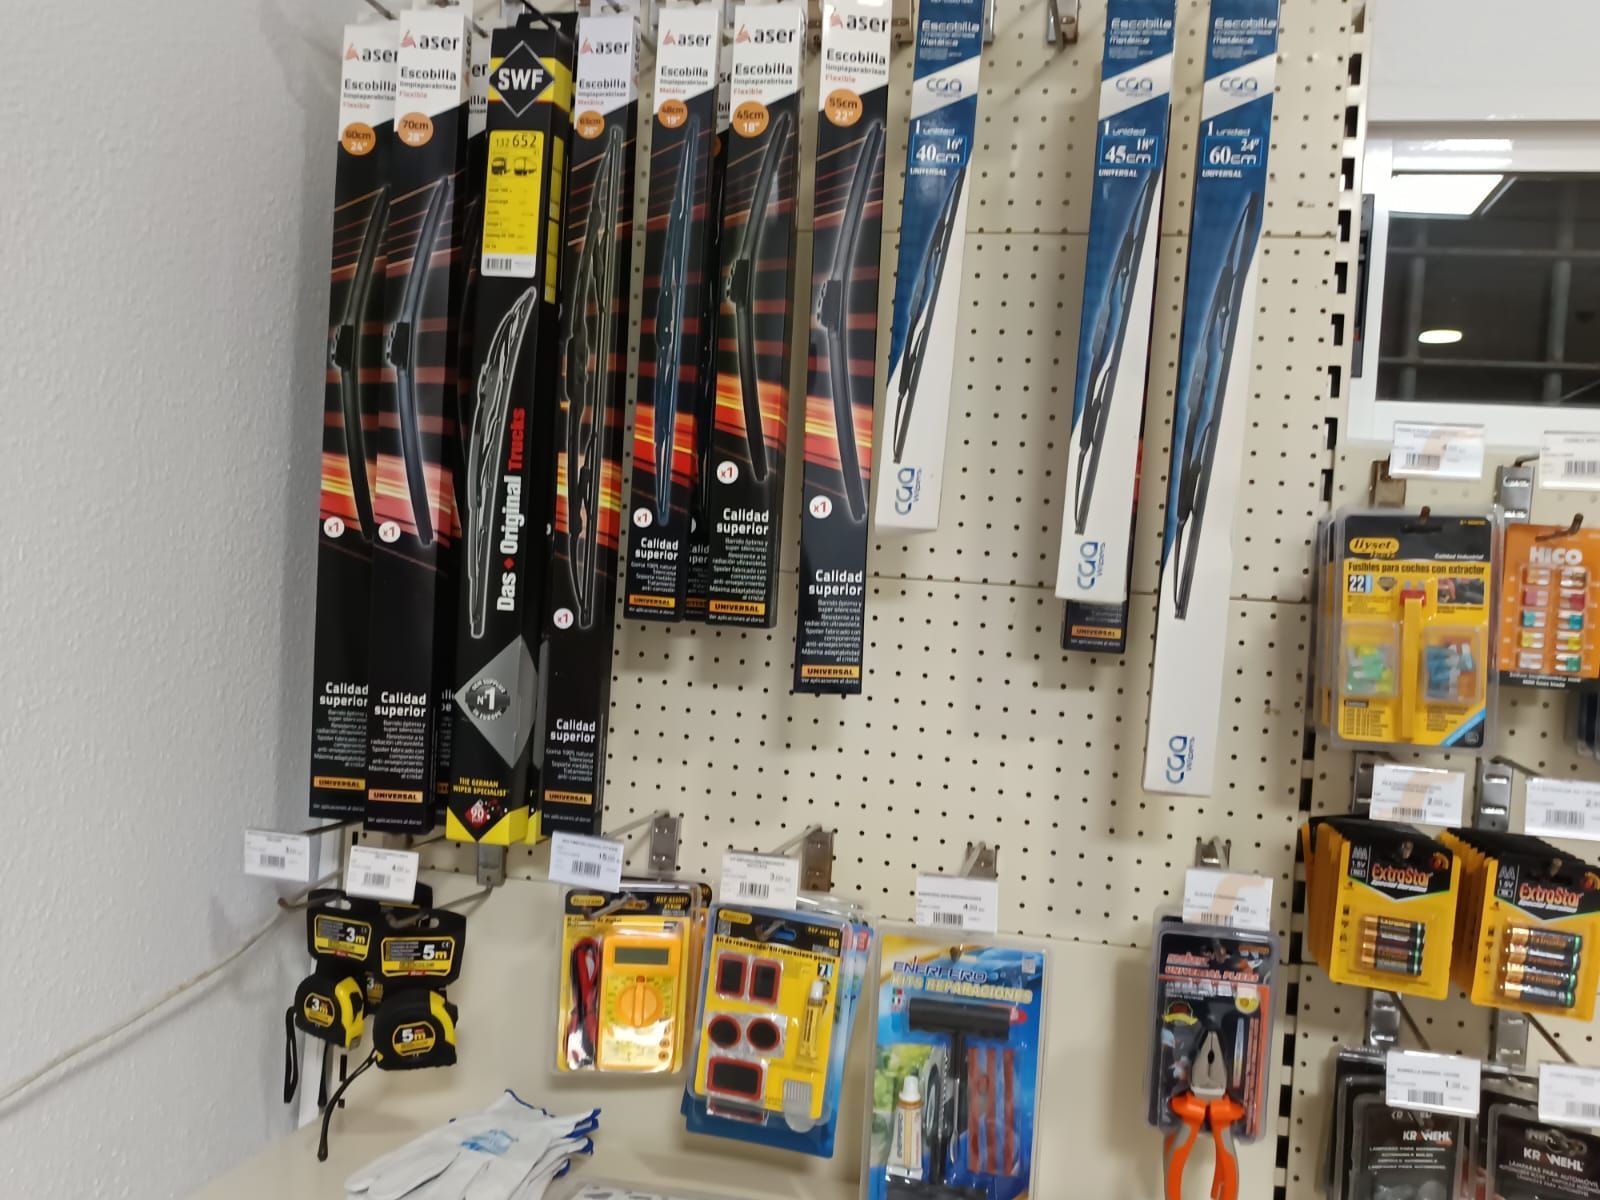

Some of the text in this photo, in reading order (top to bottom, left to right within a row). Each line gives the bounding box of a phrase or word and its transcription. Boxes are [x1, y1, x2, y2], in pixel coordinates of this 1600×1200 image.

[826, 48, 886, 65] Escobilla
[400, 66, 457, 81] Escobilla
[661, 66, 708, 78] Escobilla
[735, 62, 793, 76] Escobilla
[344, 78, 397, 93] Escobilla
[498, 68, 544, 90] SWF
[578, 78, 626, 90] Escobilla
[402, 118, 429, 132] 70cm
[512, 133, 537, 148] 652
[916, 144, 960, 163] 40cm
[1105, 145, 1151, 164] 45cm
[1209, 145, 1257, 164] 60cm
[910, 167, 947, 177] UNIVERSAL
[1099, 168, 1137, 178] UNIVERSAL
[1202, 168, 1242, 178] UNIVERSAL
[497, 408, 526, 611] Das Original Trucks
[723, 508, 769, 523] Calidad
[716, 522, 769, 537] superior
[641, 537, 679, 551] Calidad
[635, 550, 678, 562] superior
[1529, 546, 1583, 566] HICO
[1348, 562, 1485, 574] Fusibles para coches con extractor
[815, 569, 863, 584] Calidad
[1349, 575, 1366, 592] 22
[808, 583, 863, 598] superior
[714, 602, 759, 613] UNIVERSAL
[807, 667, 854, 676] UNIVERSAL
[326, 681, 369, 696] Calidad
[319, 695, 369, 708] superior
[381, 691, 427, 705] Calidad
[374, 705, 427, 718] superior
[556, 718, 596, 733] Calidad
[550, 731, 596, 744] superior
[373, 791, 418, 801] UNIVERSAL
[1371, 863, 1434, 888] ExtraStar
[1519, 882, 1585, 908] ExtraStar
[1523, 1146, 1584, 1173] KRAWEHL
